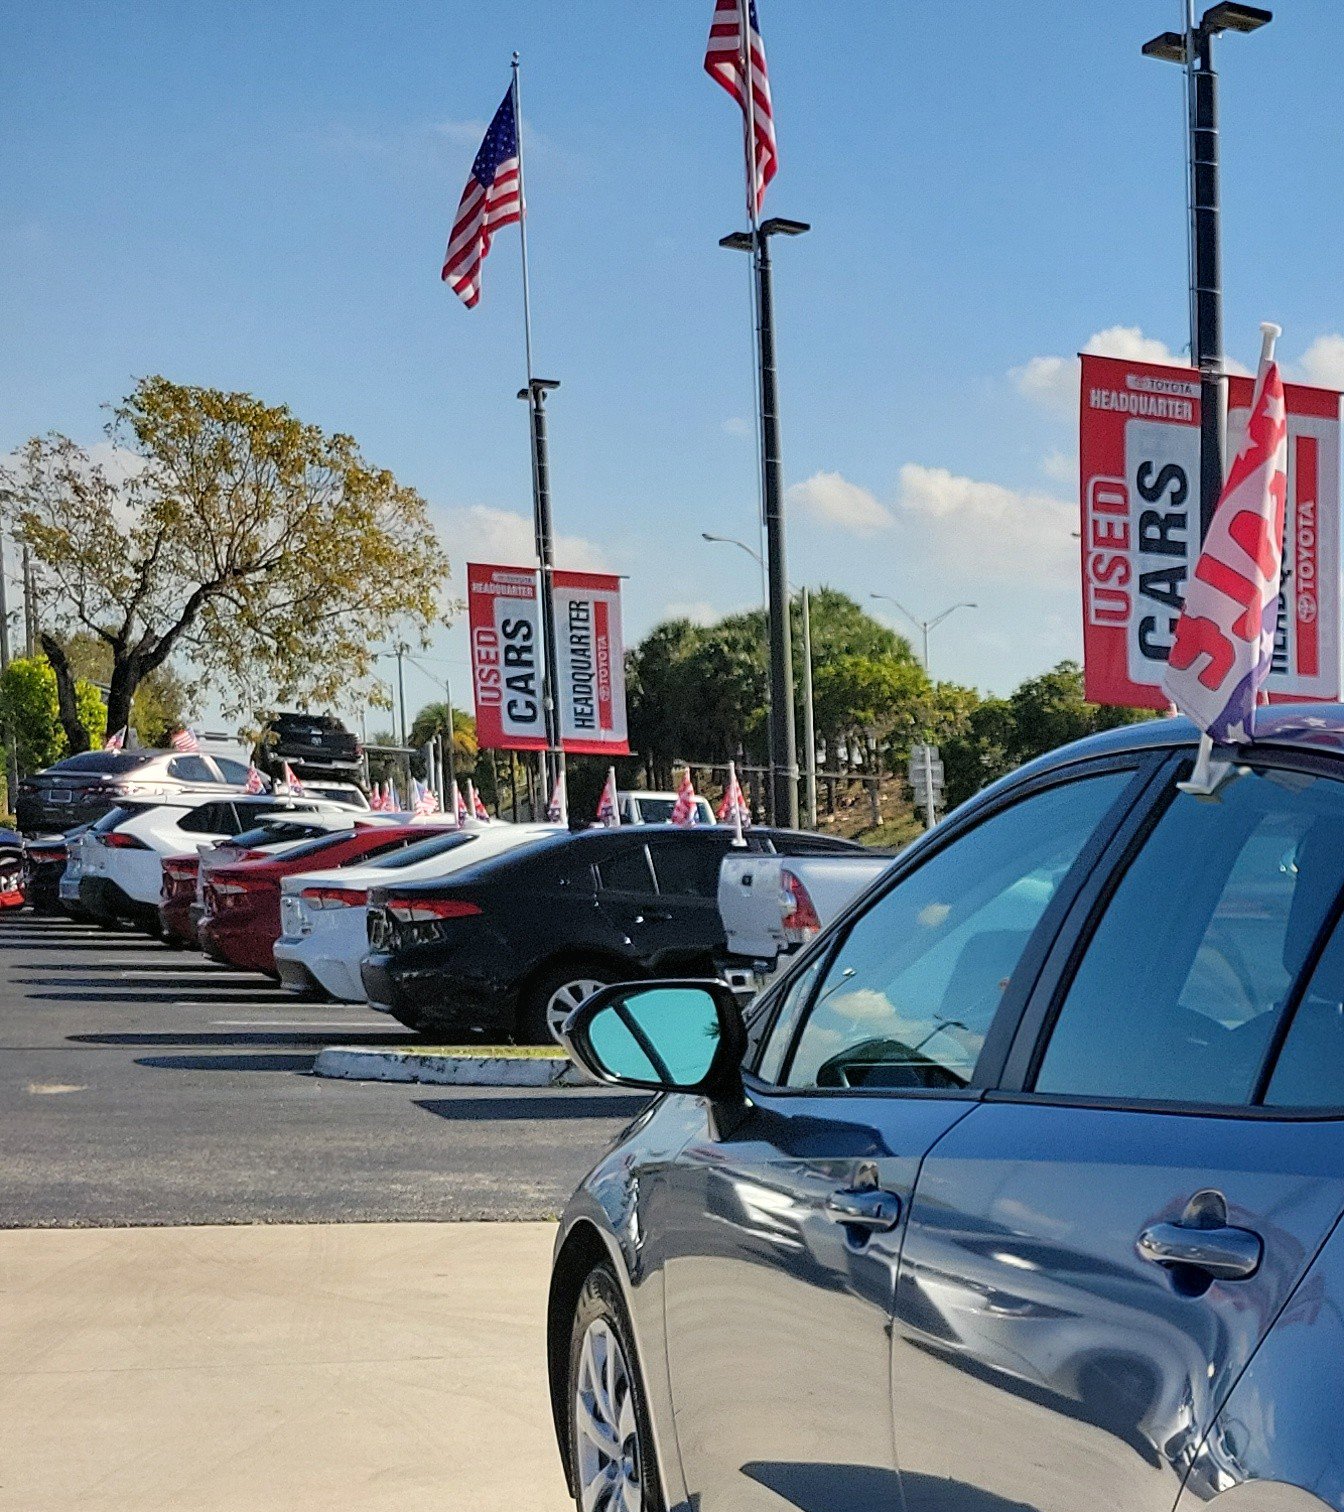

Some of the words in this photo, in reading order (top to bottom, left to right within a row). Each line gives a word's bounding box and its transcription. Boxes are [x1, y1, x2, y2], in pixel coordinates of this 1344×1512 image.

[1090, 388, 1193, 421] HEADQUARTER
[1150, 380, 1193, 394] TOYOTA
[1089, 476, 1132, 627] USED
[1136, 460, 1189, 662] CARS
[1297, 502, 1317, 594] TOYOTA
[476, 628, 502, 705] USED
[502, 619, 537, 724] CARS
[569, 600, 595, 729] HEADQUARTER
